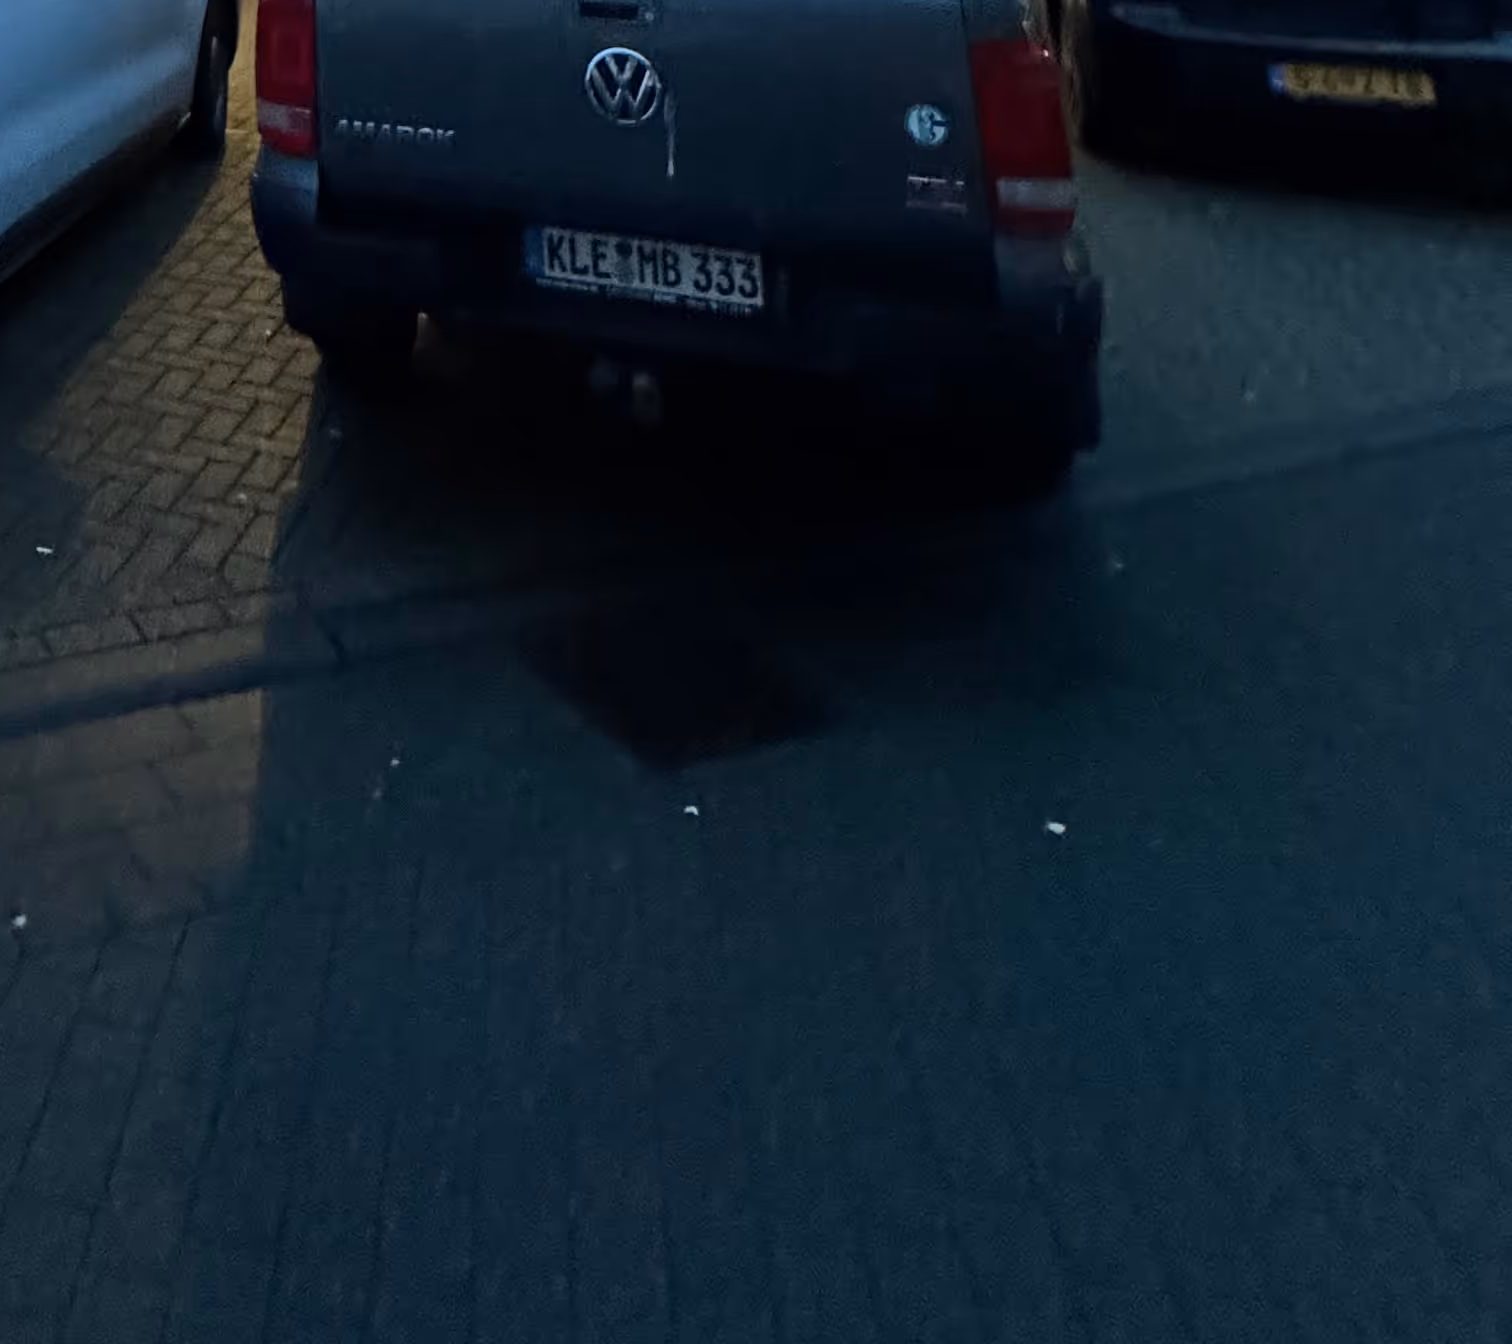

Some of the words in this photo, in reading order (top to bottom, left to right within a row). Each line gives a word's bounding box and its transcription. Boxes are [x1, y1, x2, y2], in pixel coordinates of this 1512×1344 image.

[546, 232, 611, 279] KLE
[637, 245, 682, 288] MB
[690, 252, 759, 299] 333
